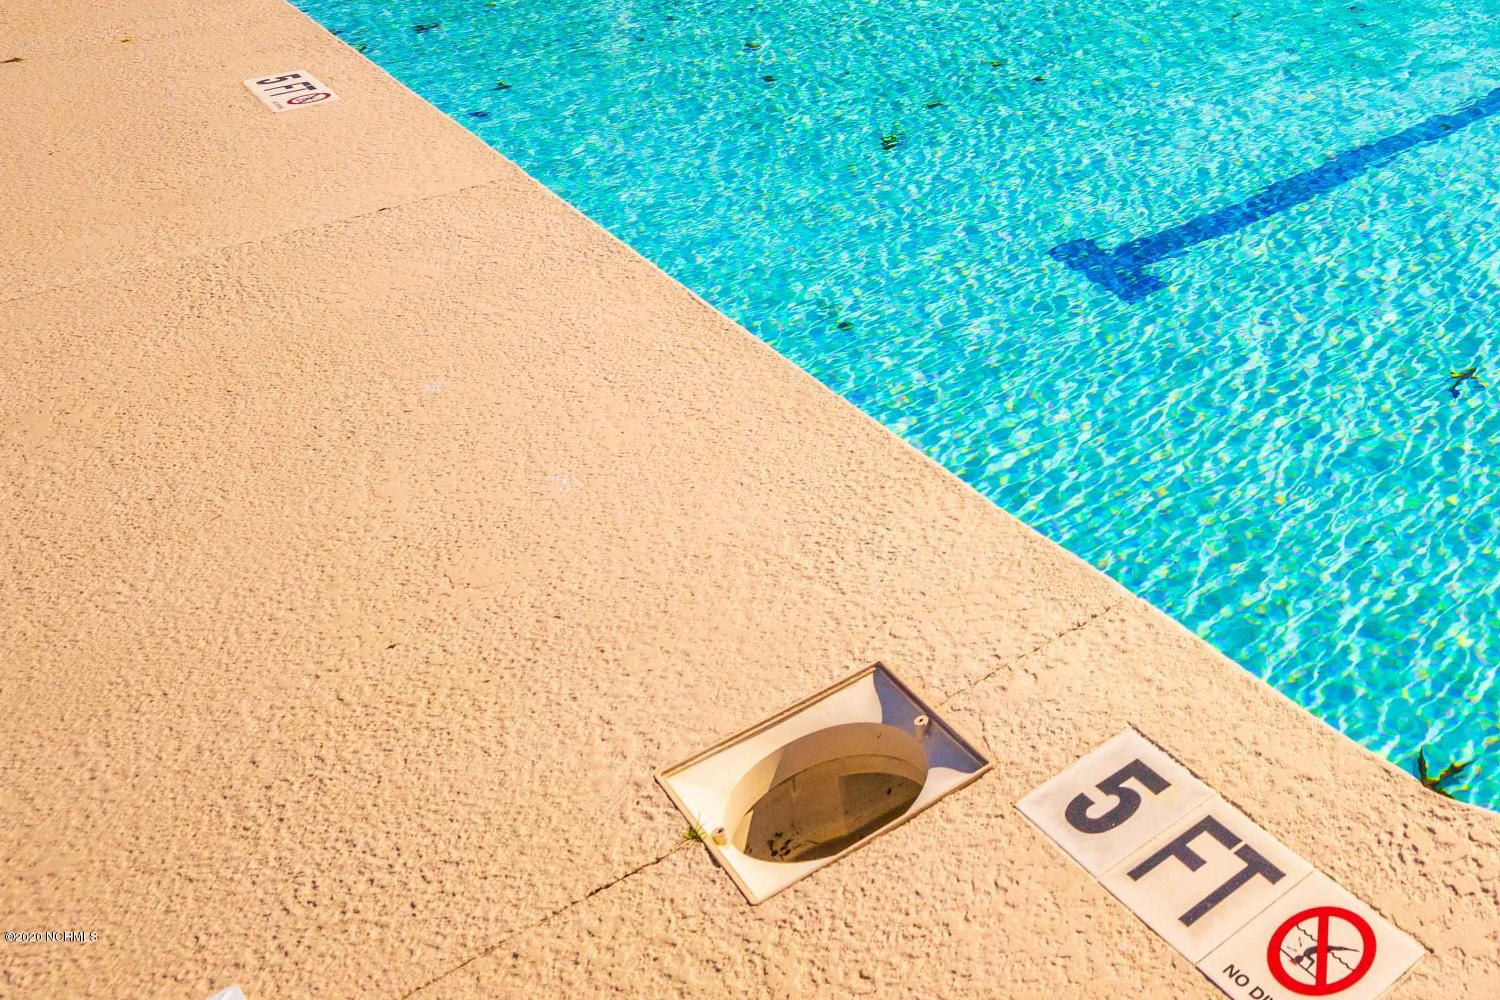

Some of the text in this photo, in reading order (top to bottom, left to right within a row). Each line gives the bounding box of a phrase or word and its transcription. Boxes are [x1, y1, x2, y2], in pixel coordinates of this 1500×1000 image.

[256, 73, 317, 97] 5 FT
[1064, 758, 1287, 928] 5 FT
[1222, 963, 1251, 988] NO
